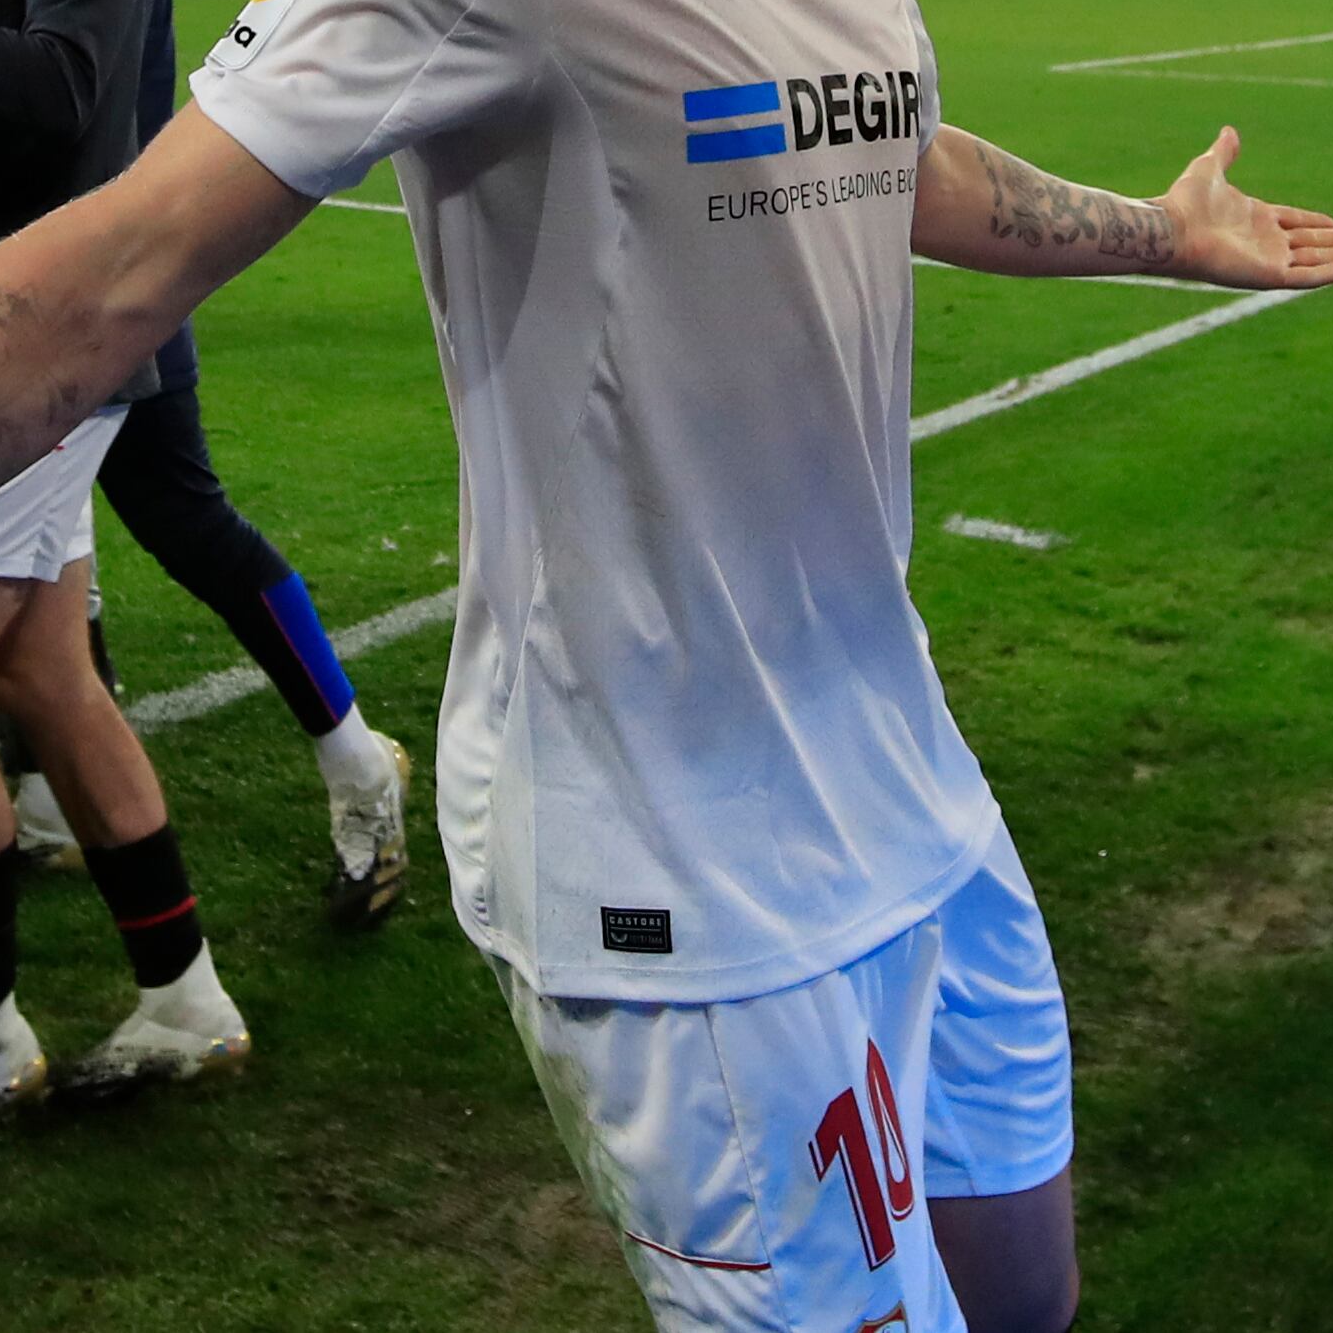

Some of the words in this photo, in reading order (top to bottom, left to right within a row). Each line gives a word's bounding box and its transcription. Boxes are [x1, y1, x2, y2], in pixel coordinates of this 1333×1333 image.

[787, 70, 922, 152] DEGIR
[708, 180, 828, 222] EUROPE'S
[831, 169, 892, 204] LEADING
[808, 1036, 915, 1272] 10
